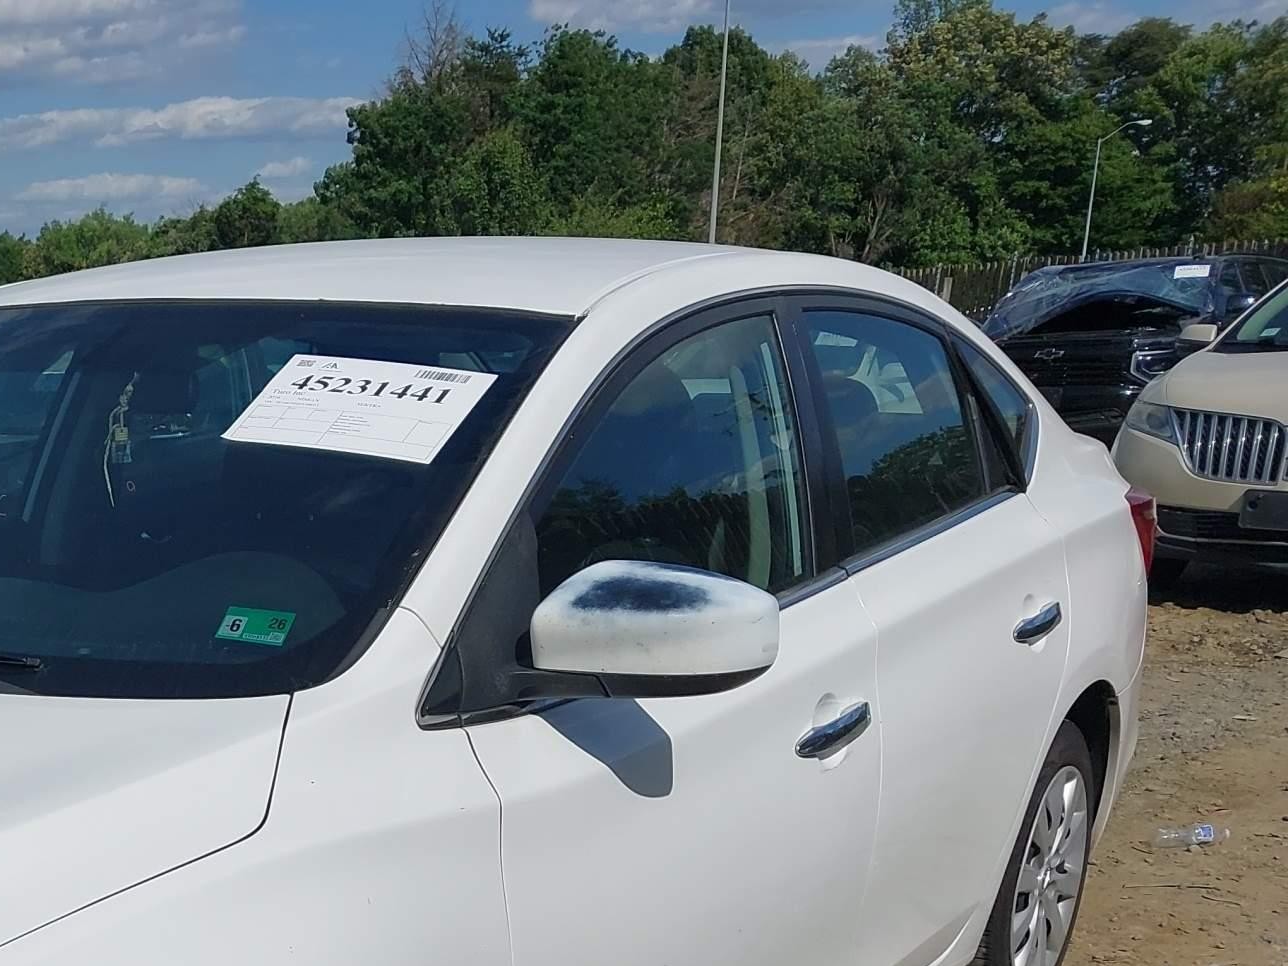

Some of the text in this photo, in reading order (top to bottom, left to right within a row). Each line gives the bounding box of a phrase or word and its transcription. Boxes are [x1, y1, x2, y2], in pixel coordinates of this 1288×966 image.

[290, 374, 452, 405] 45231441
[229, 617, 288, 633] 6 26
